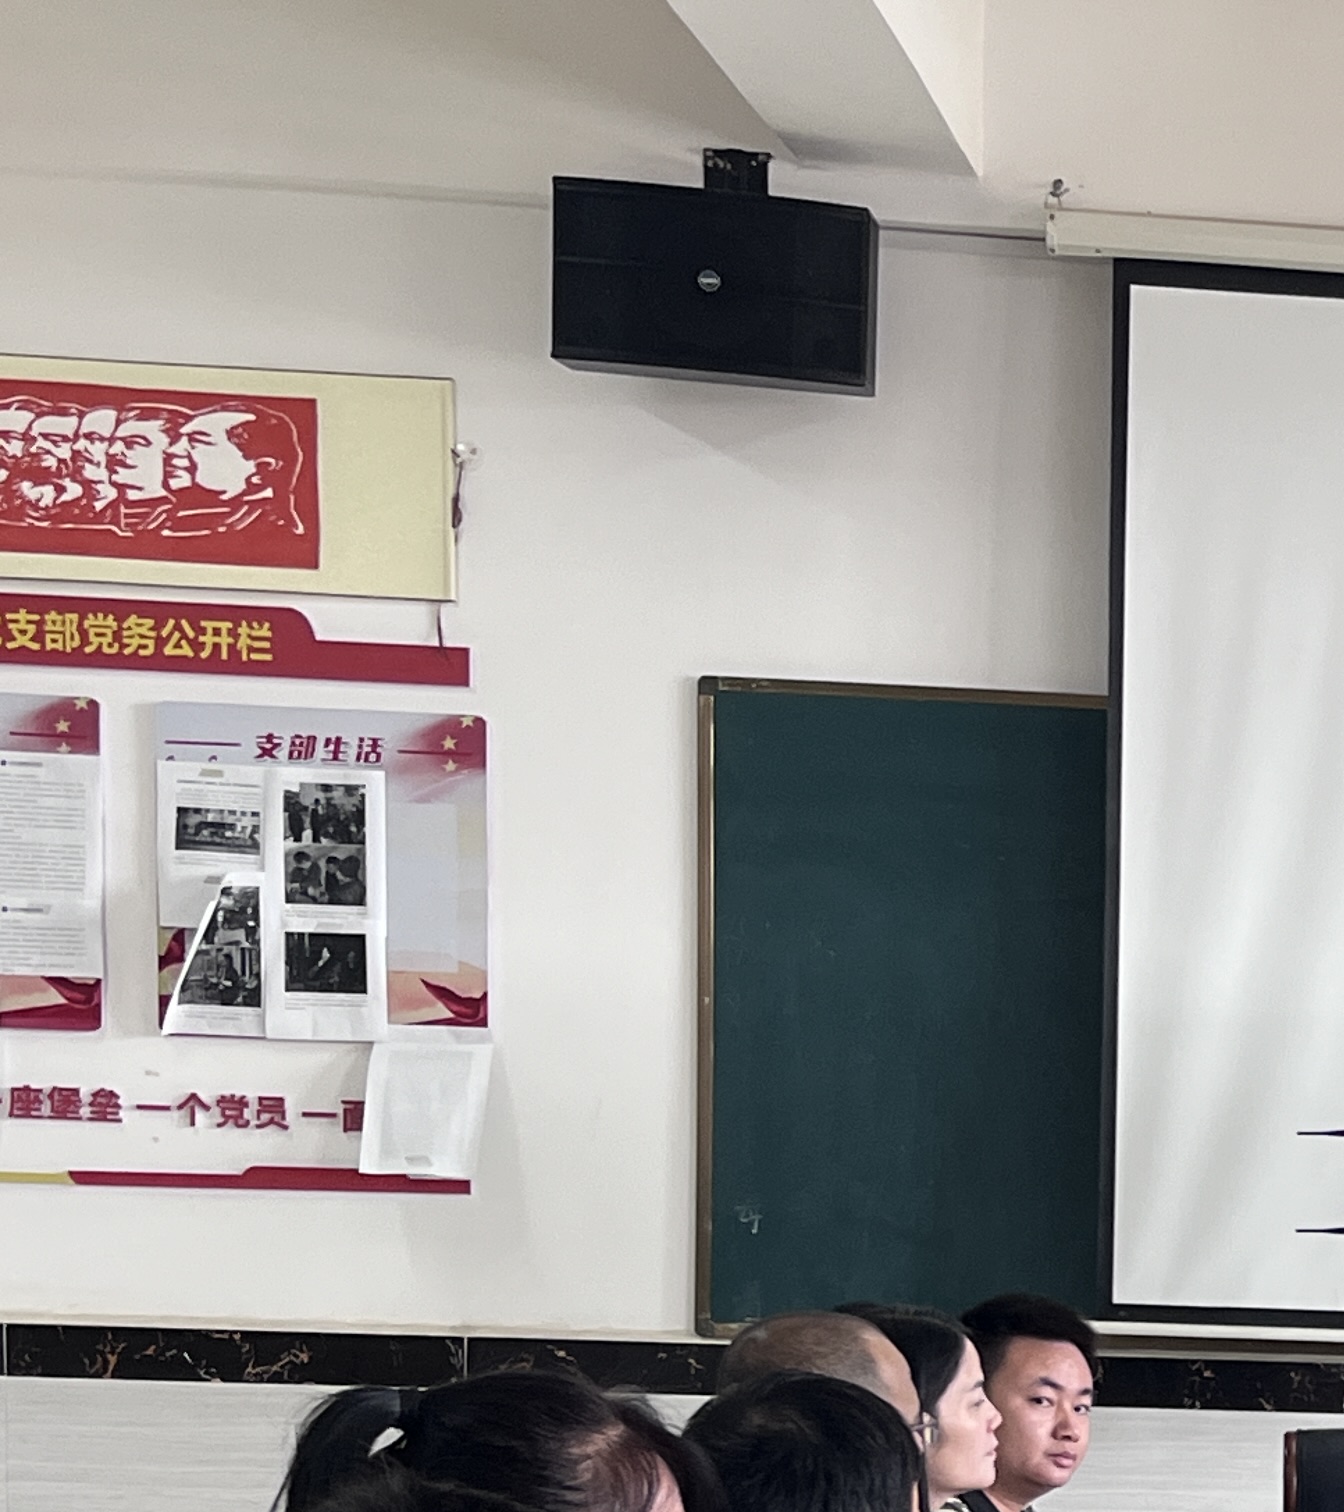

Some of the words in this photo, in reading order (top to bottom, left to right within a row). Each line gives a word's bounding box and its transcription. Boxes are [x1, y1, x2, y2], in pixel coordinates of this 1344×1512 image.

[0, 609, 273, 662] 支部党务公开栏
[256, 732, 384, 765] 支部生活
[0, 1085, 122, 1123] 座堡垒
